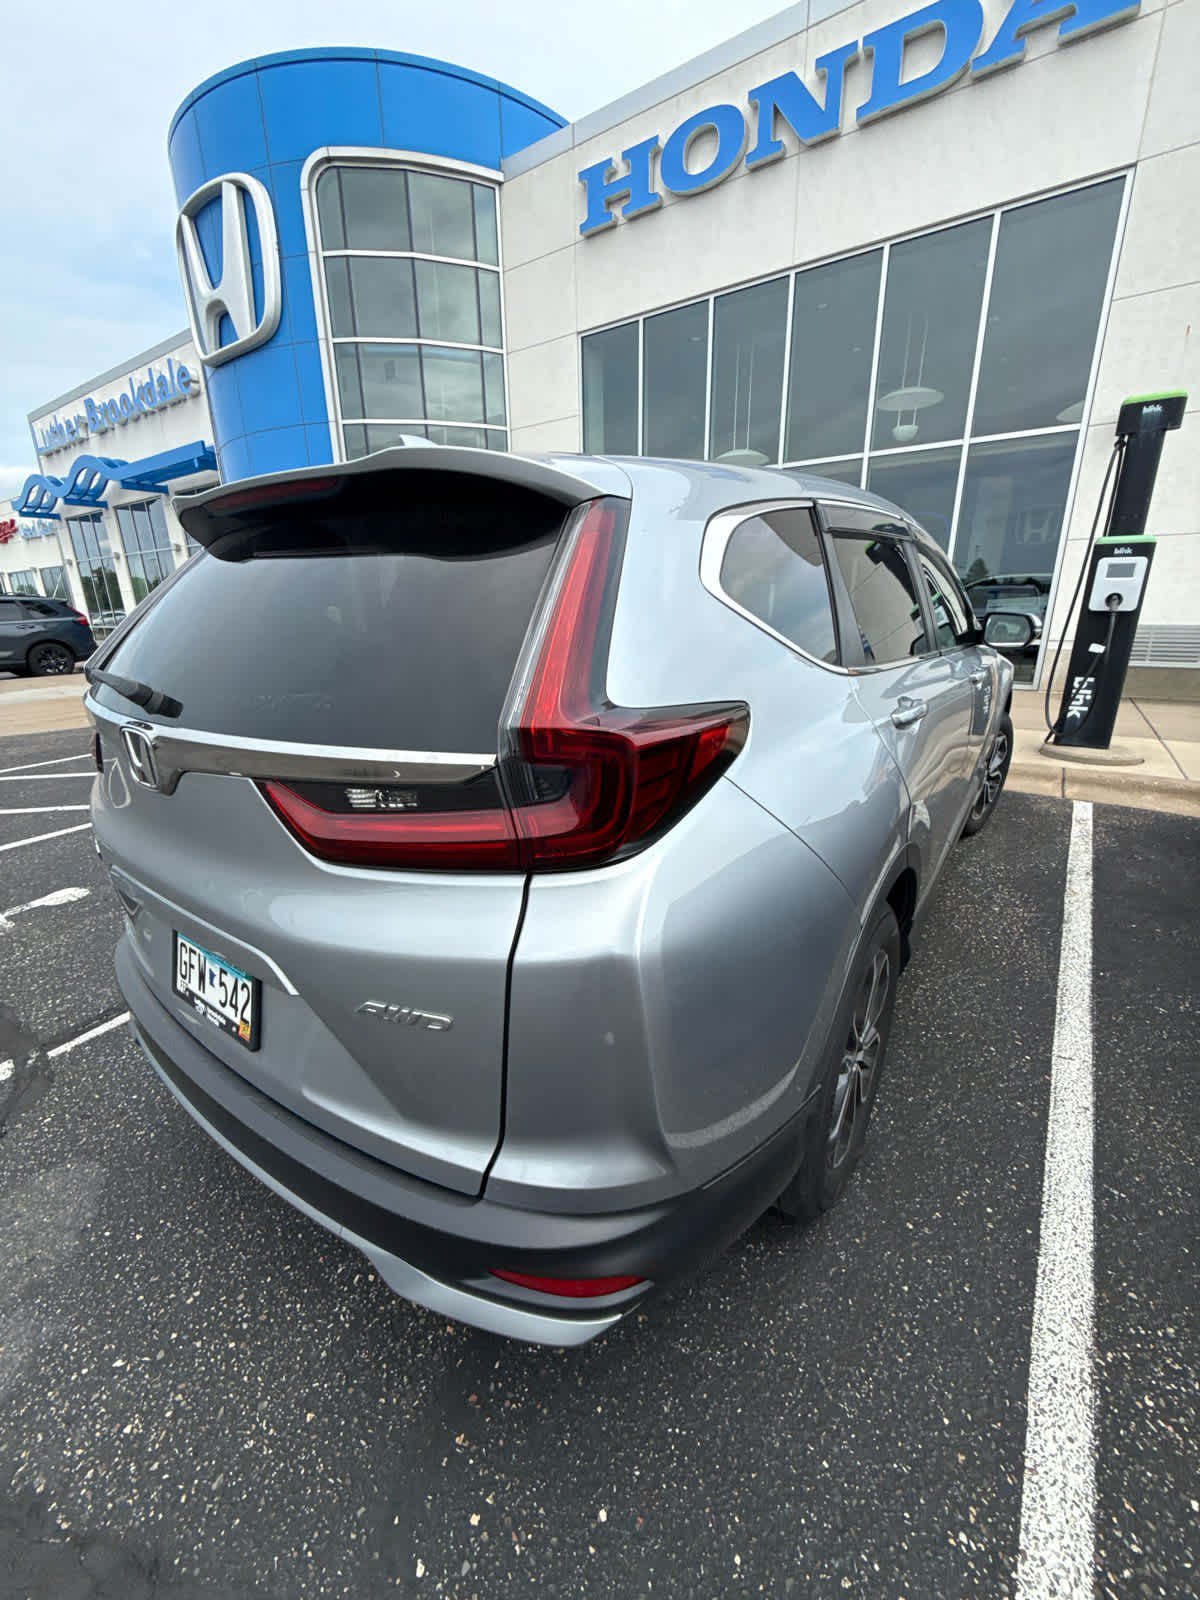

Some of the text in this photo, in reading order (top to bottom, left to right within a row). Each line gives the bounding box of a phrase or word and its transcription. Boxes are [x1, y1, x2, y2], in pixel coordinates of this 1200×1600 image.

[84, 357, 194, 433] Brookdale
[180, 942, 251, 1026] GFW 542
[354, 1000, 455, 1033] AWD
